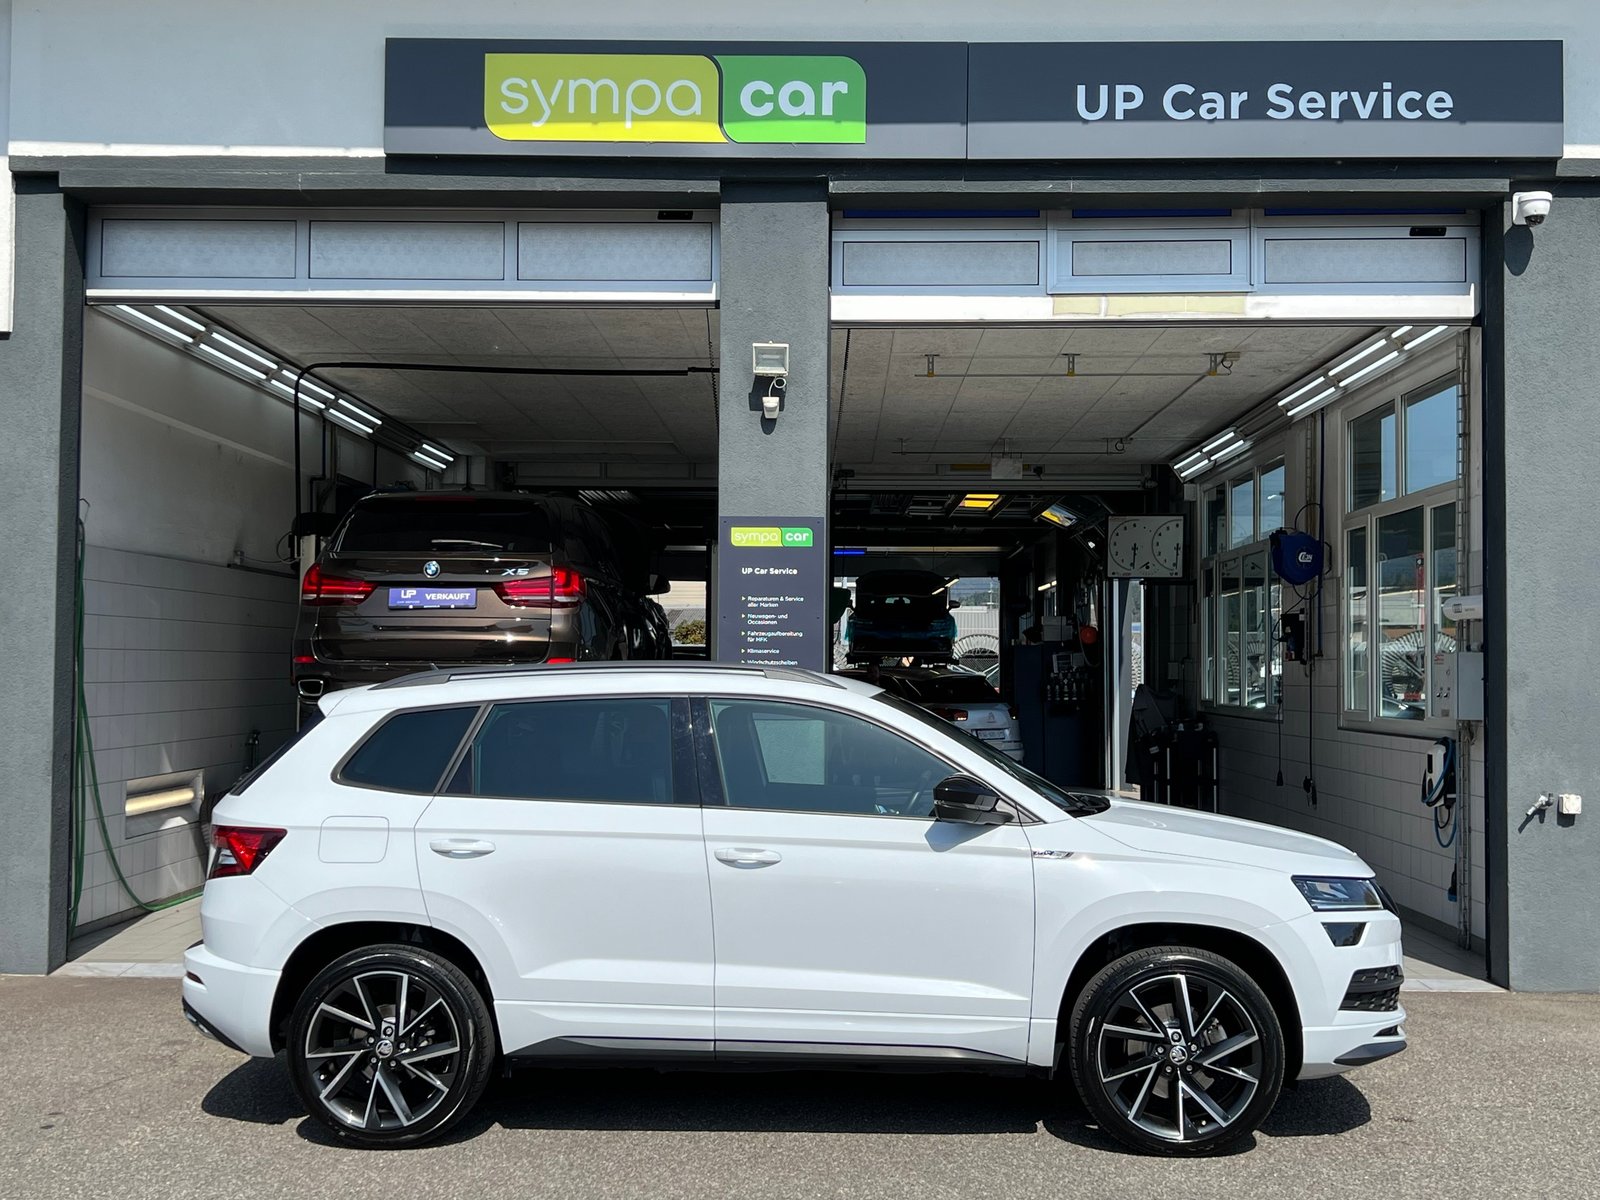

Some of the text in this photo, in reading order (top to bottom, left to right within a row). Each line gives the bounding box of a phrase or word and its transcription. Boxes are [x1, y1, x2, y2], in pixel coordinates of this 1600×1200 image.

[500, 76, 702, 129] sympa
[739, 79, 849, 117] car
[1076, 82, 1454, 121] UP Car Service
[734, 531, 779, 544] sympa
[785, 532, 809, 542] car
[502, 568, 530, 576] X5
[741, 567, 798, 575] UP Car Service
[401, 589, 417, 599] UP
[425, 592, 471, 601] VERKAUFT
